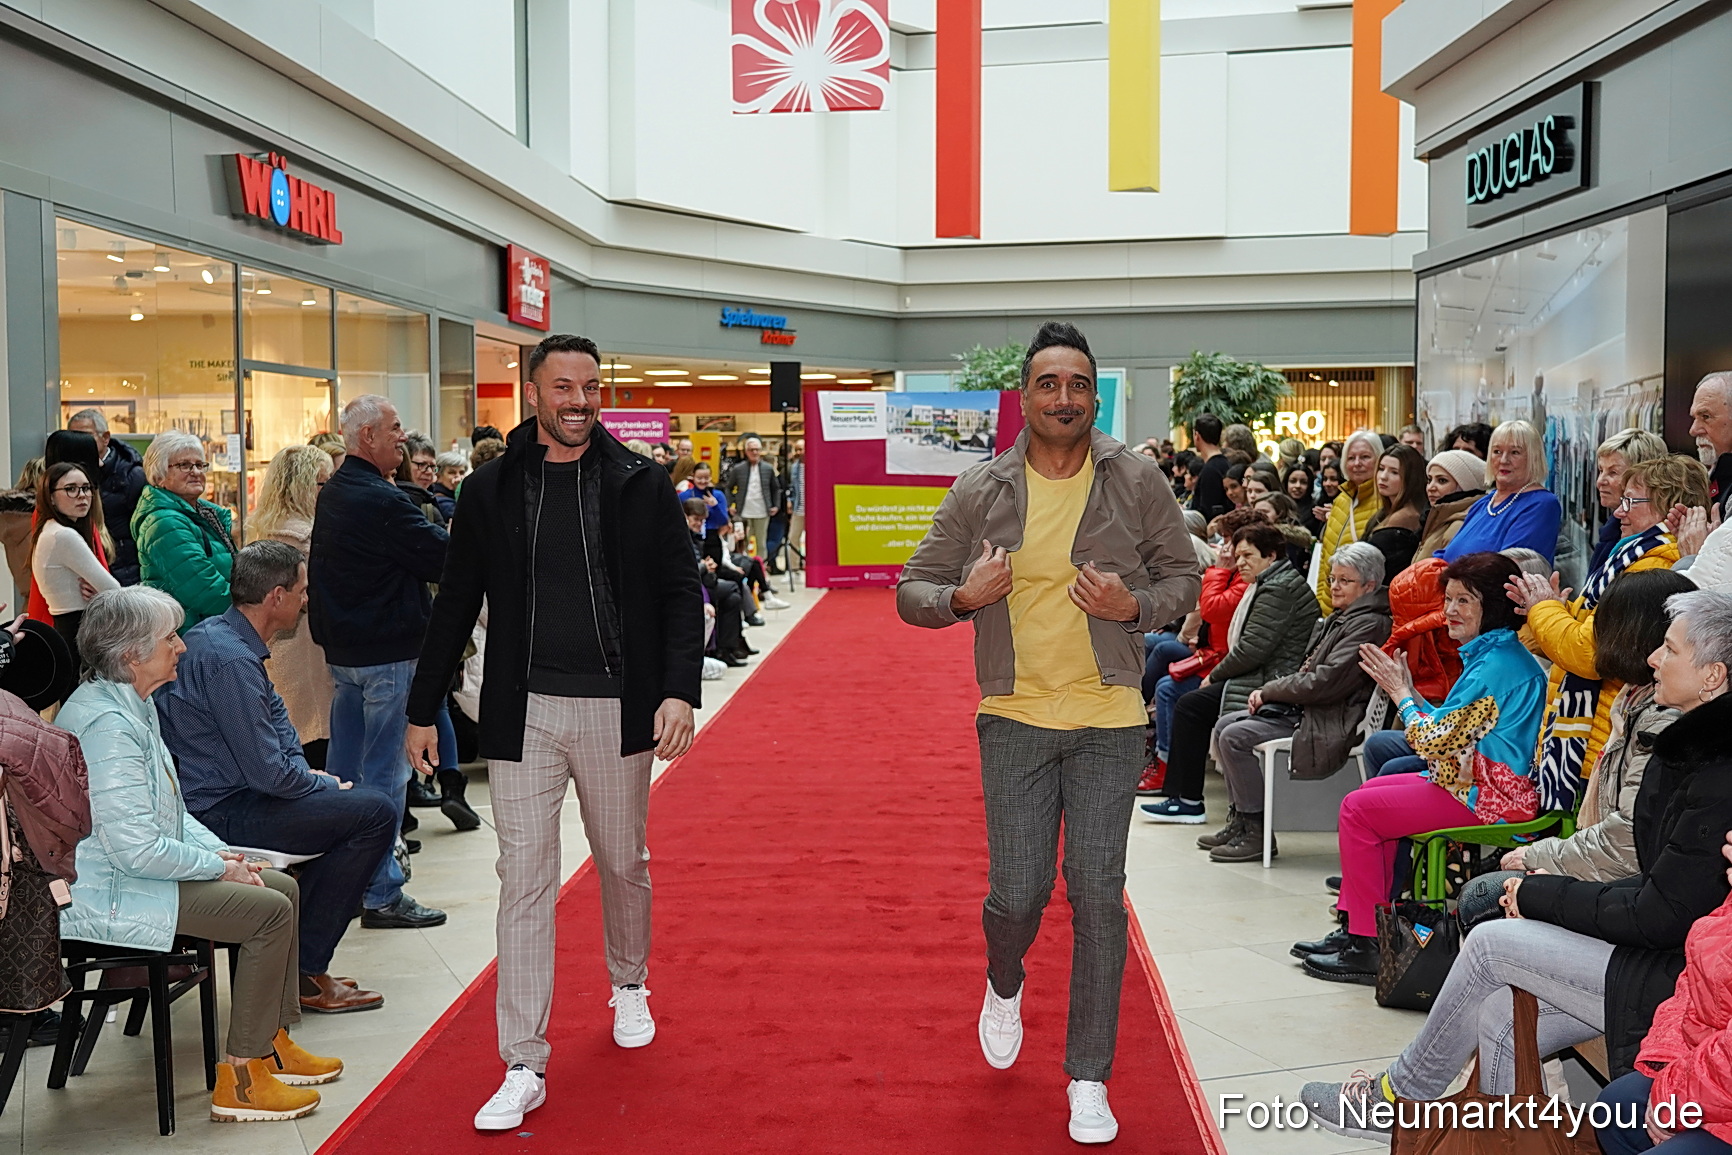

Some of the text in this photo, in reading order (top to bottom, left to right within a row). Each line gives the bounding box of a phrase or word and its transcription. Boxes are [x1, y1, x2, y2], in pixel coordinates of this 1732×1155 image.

[1465, 115, 1555, 205] DOUGLAS
[235, 151, 342, 245] WÖHRL
[721, 307, 787, 328] Spielwaren
[189, 360, 205, 368] THE
[605, 420, 664, 429] Verschenken Sie
[619, 429, 664, 438] Gutscheine!
[849, 514, 875, 522] Schuhe
[870, 523, 896, 531] deinen
